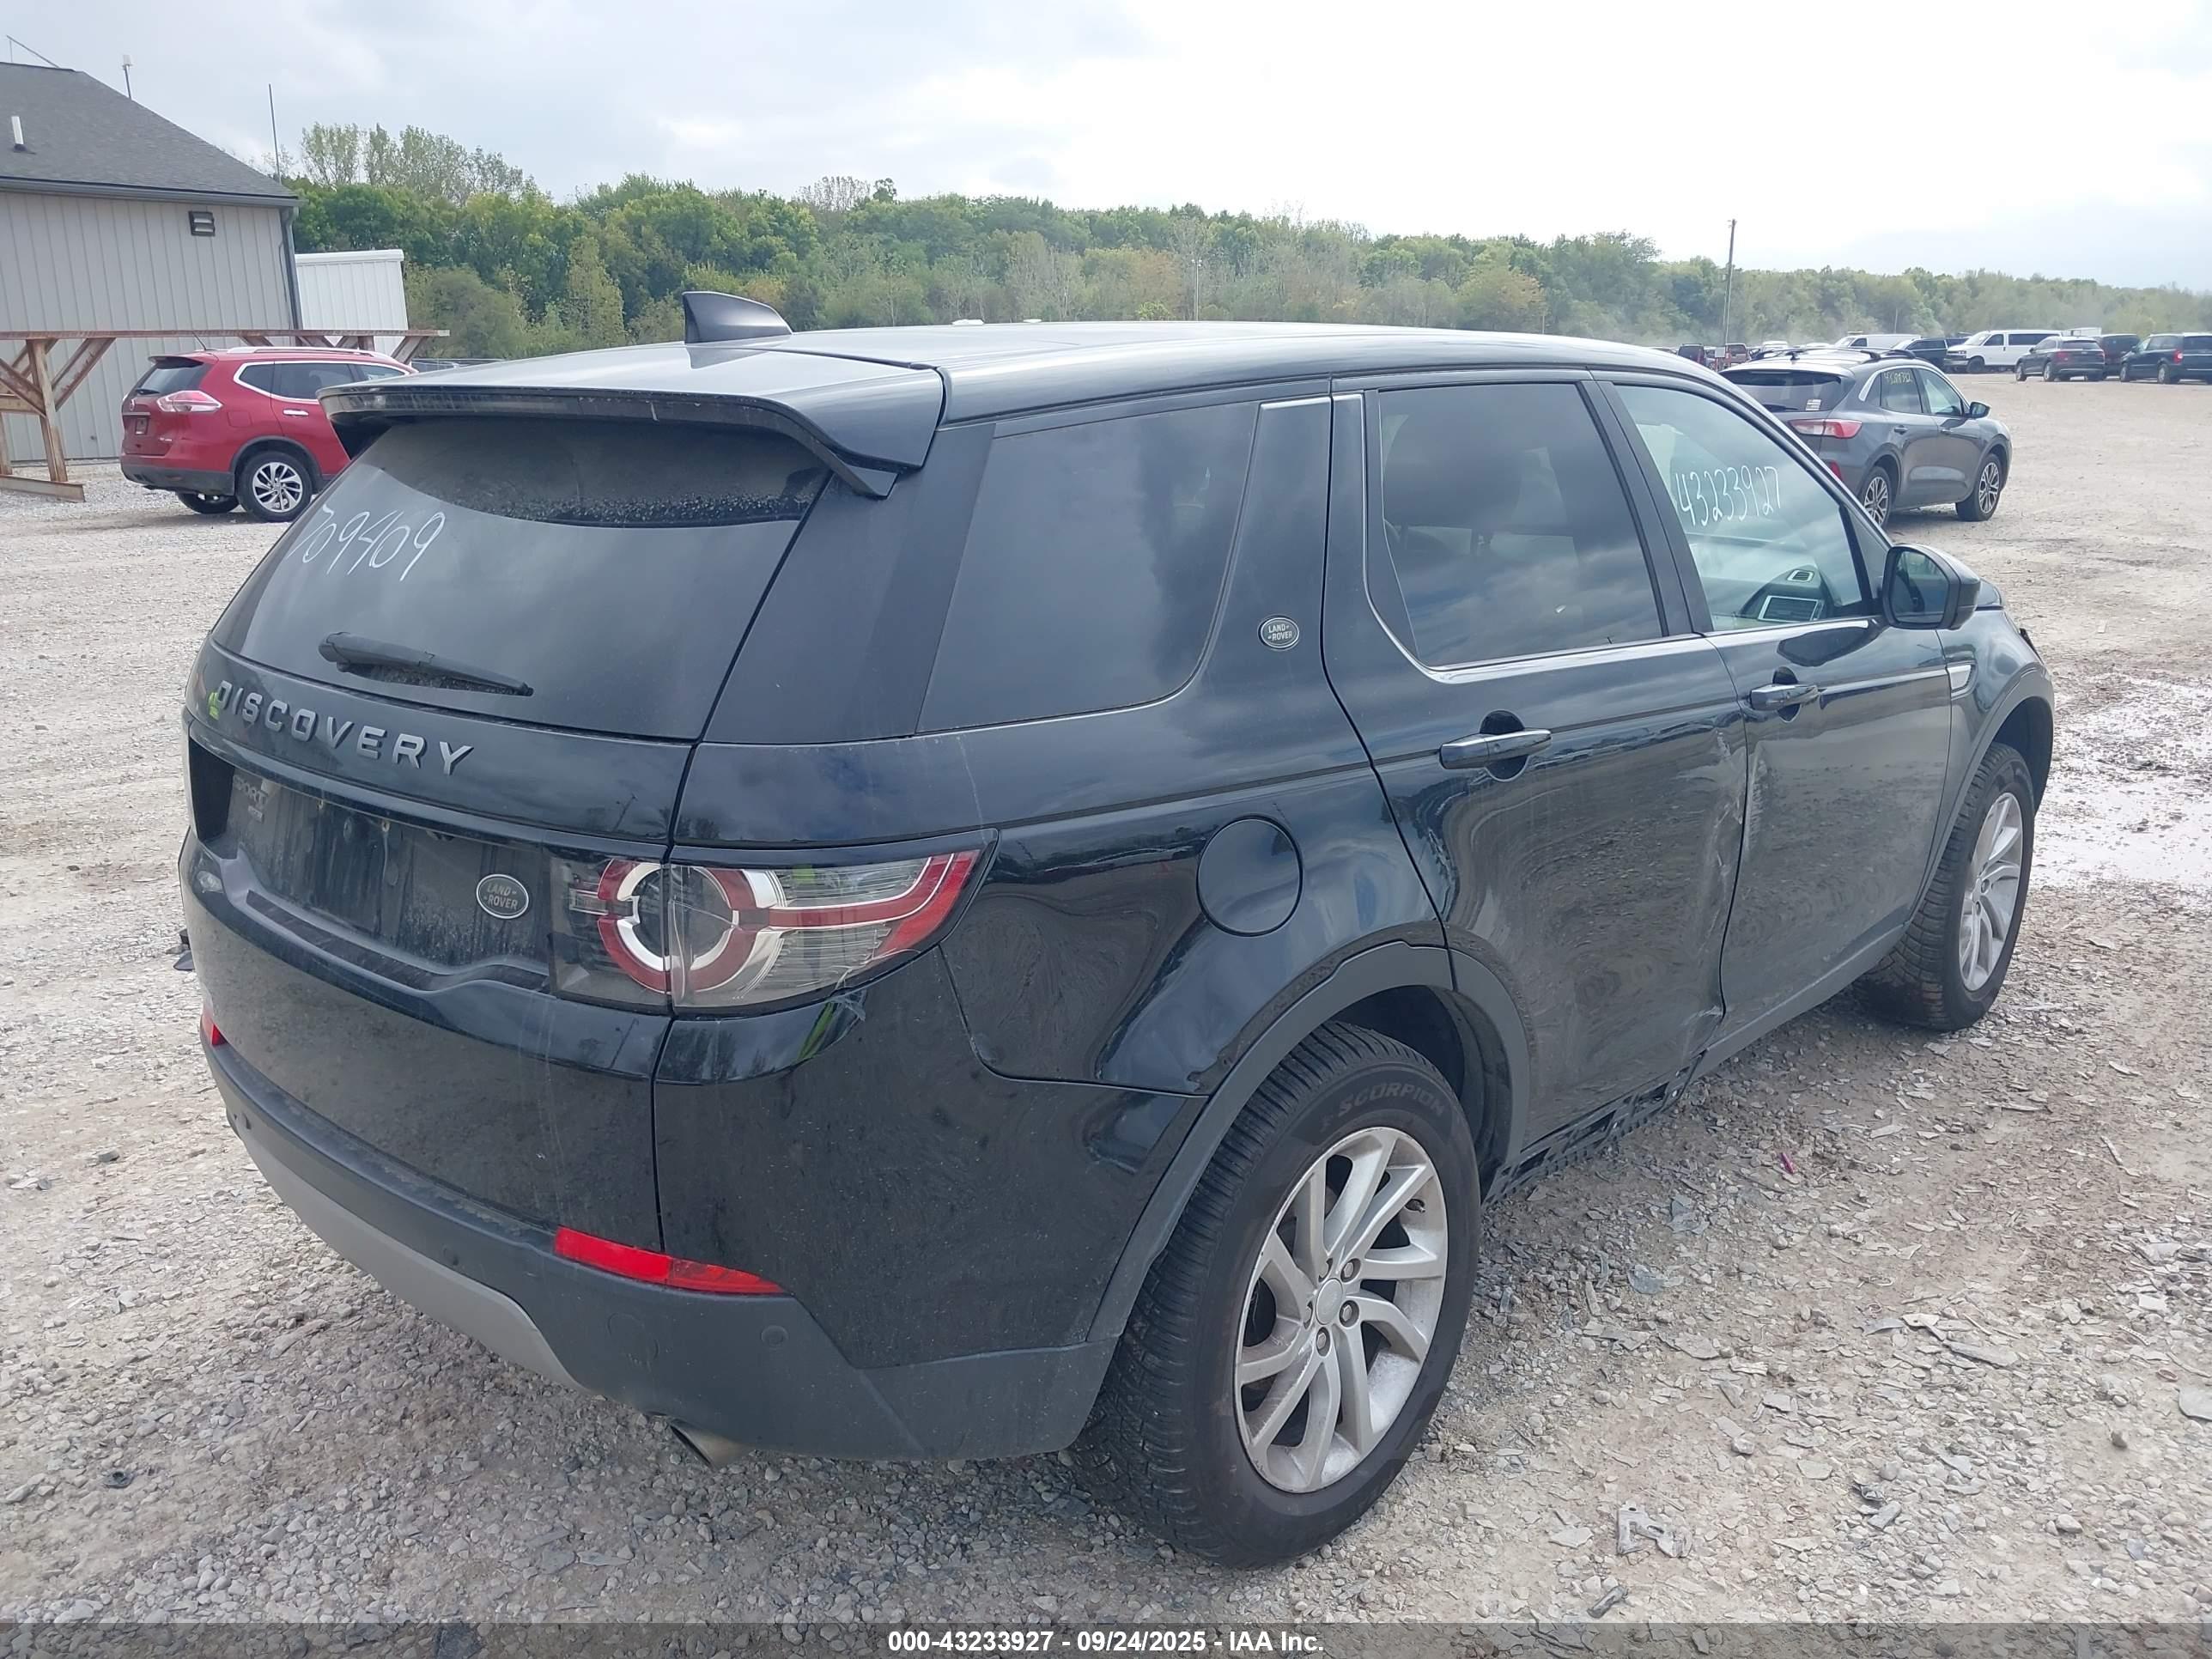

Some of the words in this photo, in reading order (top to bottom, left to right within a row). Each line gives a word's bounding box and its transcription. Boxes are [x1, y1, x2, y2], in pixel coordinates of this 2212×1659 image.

[1675, 465, 1781, 526] 43233927
[286, 503, 446, 581] 709409
[1267, 623, 1285, 634] LAND
[1272, 630, 1292, 641] ROVER
[216, 679, 474, 776] DISCOVERY
[487, 883, 512, 896] LAND
[488, 894, 518, 910] ROVER
[1339, 1082, 1444, 1115] SCORPION
